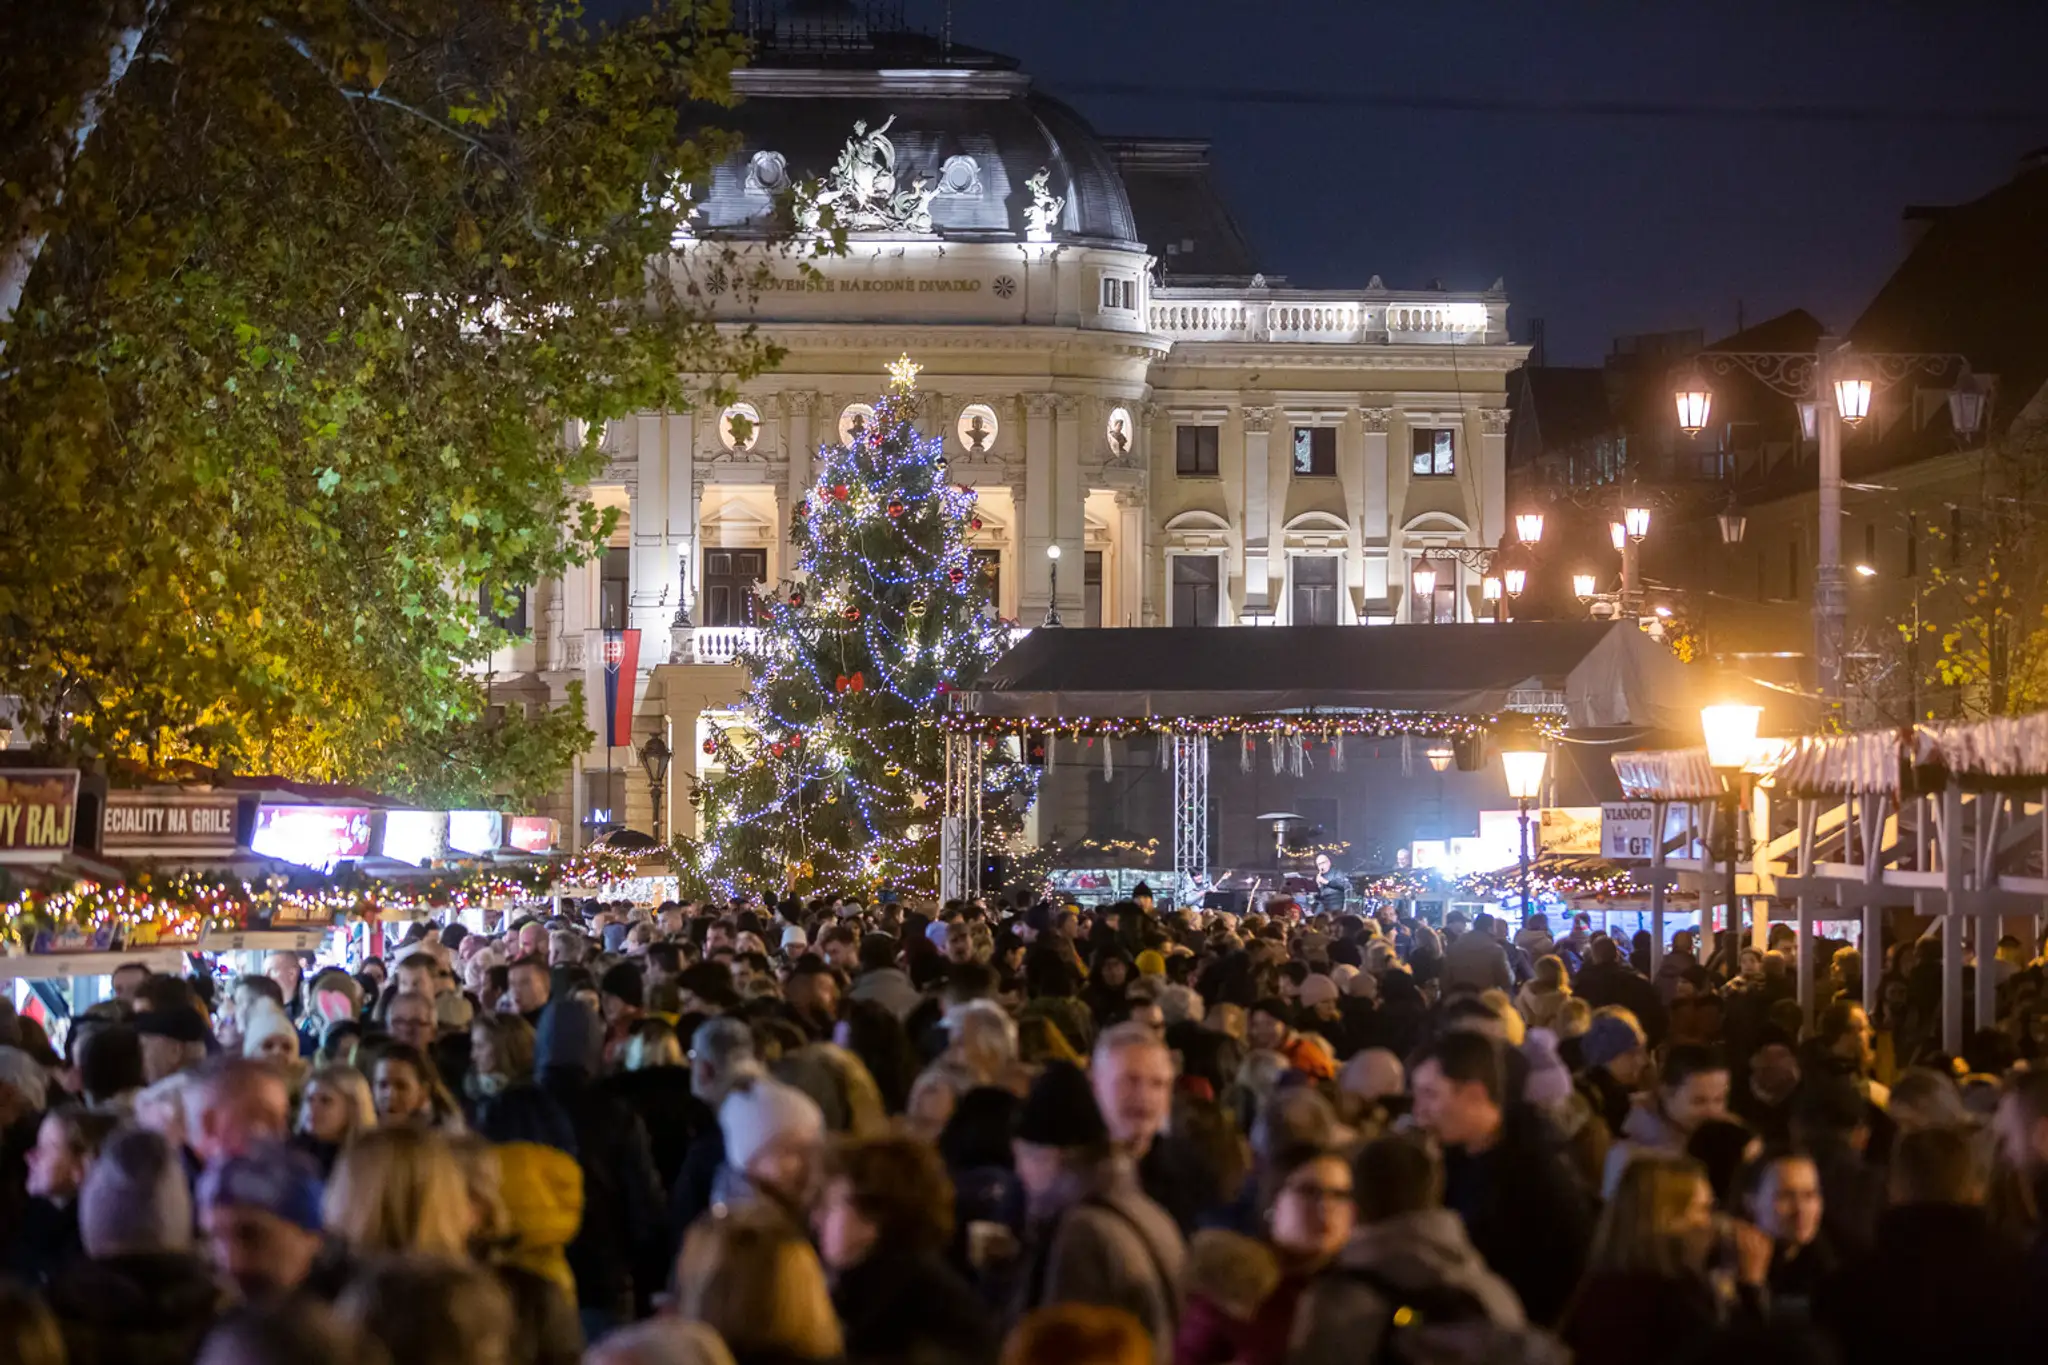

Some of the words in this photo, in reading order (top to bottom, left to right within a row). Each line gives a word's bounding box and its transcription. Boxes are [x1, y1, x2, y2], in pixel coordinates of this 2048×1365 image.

[918, 279, 981, 292] DIVADLO
[25, 804, 72, 846] RAJ
[104, 808, 164, 832] ECIALITY
[168, 808, 187, 832] NA
[192, 808, 231, 833] GRILE
